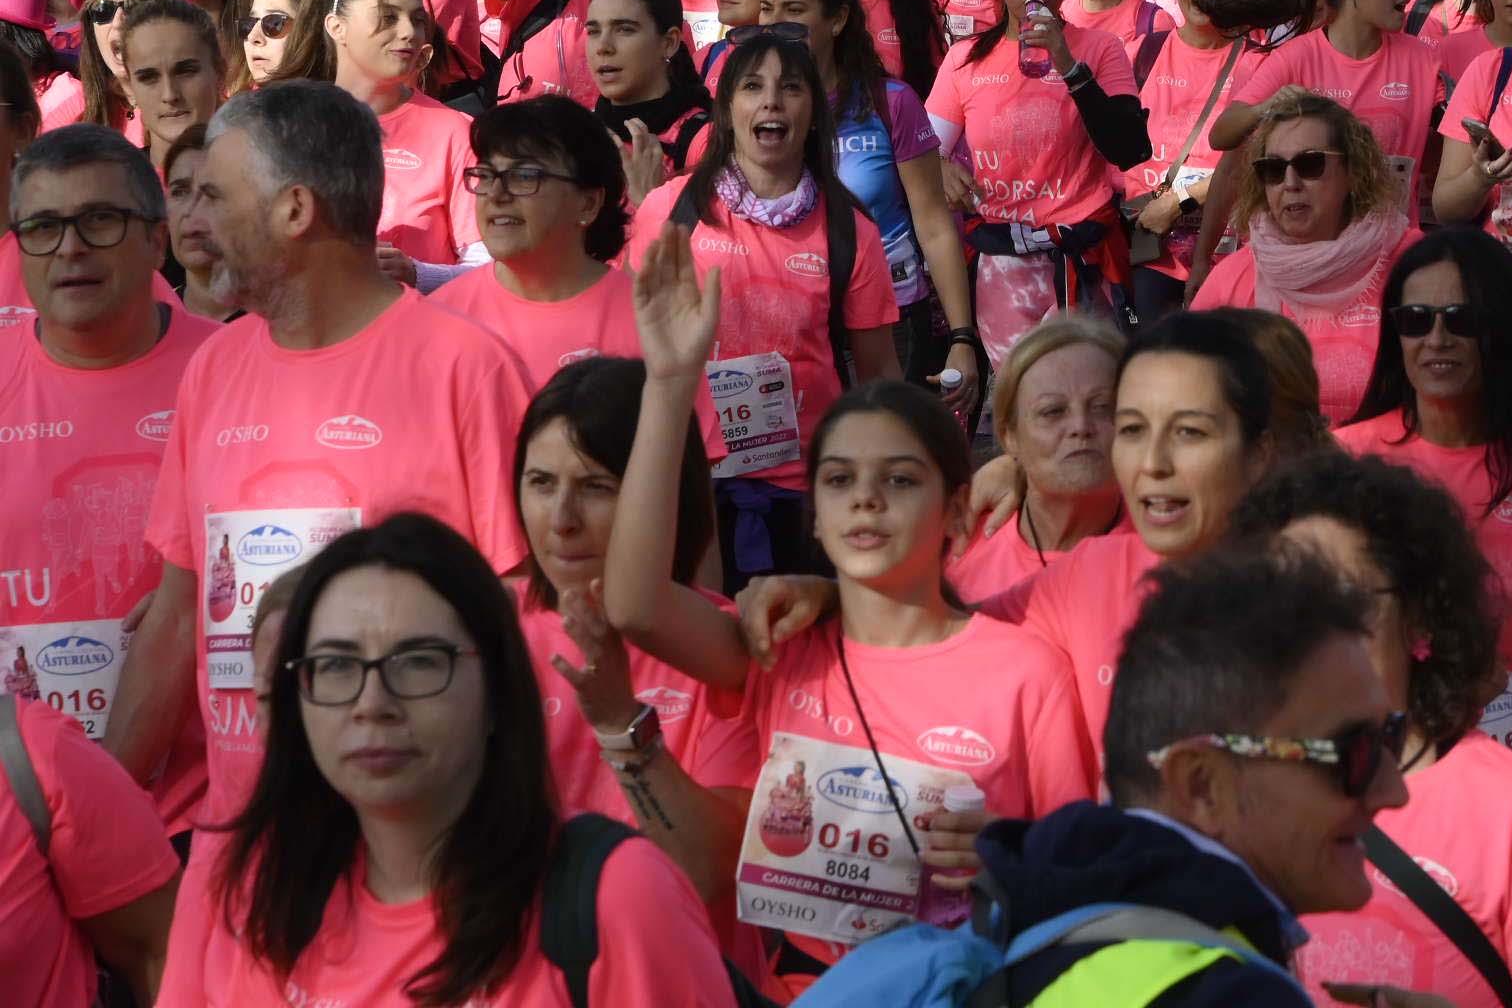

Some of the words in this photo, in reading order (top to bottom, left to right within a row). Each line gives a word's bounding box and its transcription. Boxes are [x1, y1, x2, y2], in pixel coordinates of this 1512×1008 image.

[972, 74, 1010, 87] OYSHO
[975, 149, 1000, 171] TU
[983, 178, 1066, 200] DORSAL
[698, 237, 750, 256] OYSHO
[716, 404, 752, 424] 16
[0, 419, 75, 443] OYSHO
[239, 540, 298, 557] ASTURIANA
[0, 567, 51, 609] TU
[40, 651, 109, 668] ASTURIANA
[923, 735, 992, 761] ASTURIANA
[817, 822, 890, 859] 016
[825, 859, 871, 884] 8084
[762, 871, 821, 895] CARRERA
[822, 884, 840, 899] DE
[841, 887, 858, 902] LA
[860, 891, 903, 908] MUJER
[750, 896, 818, 923] OYSHO
